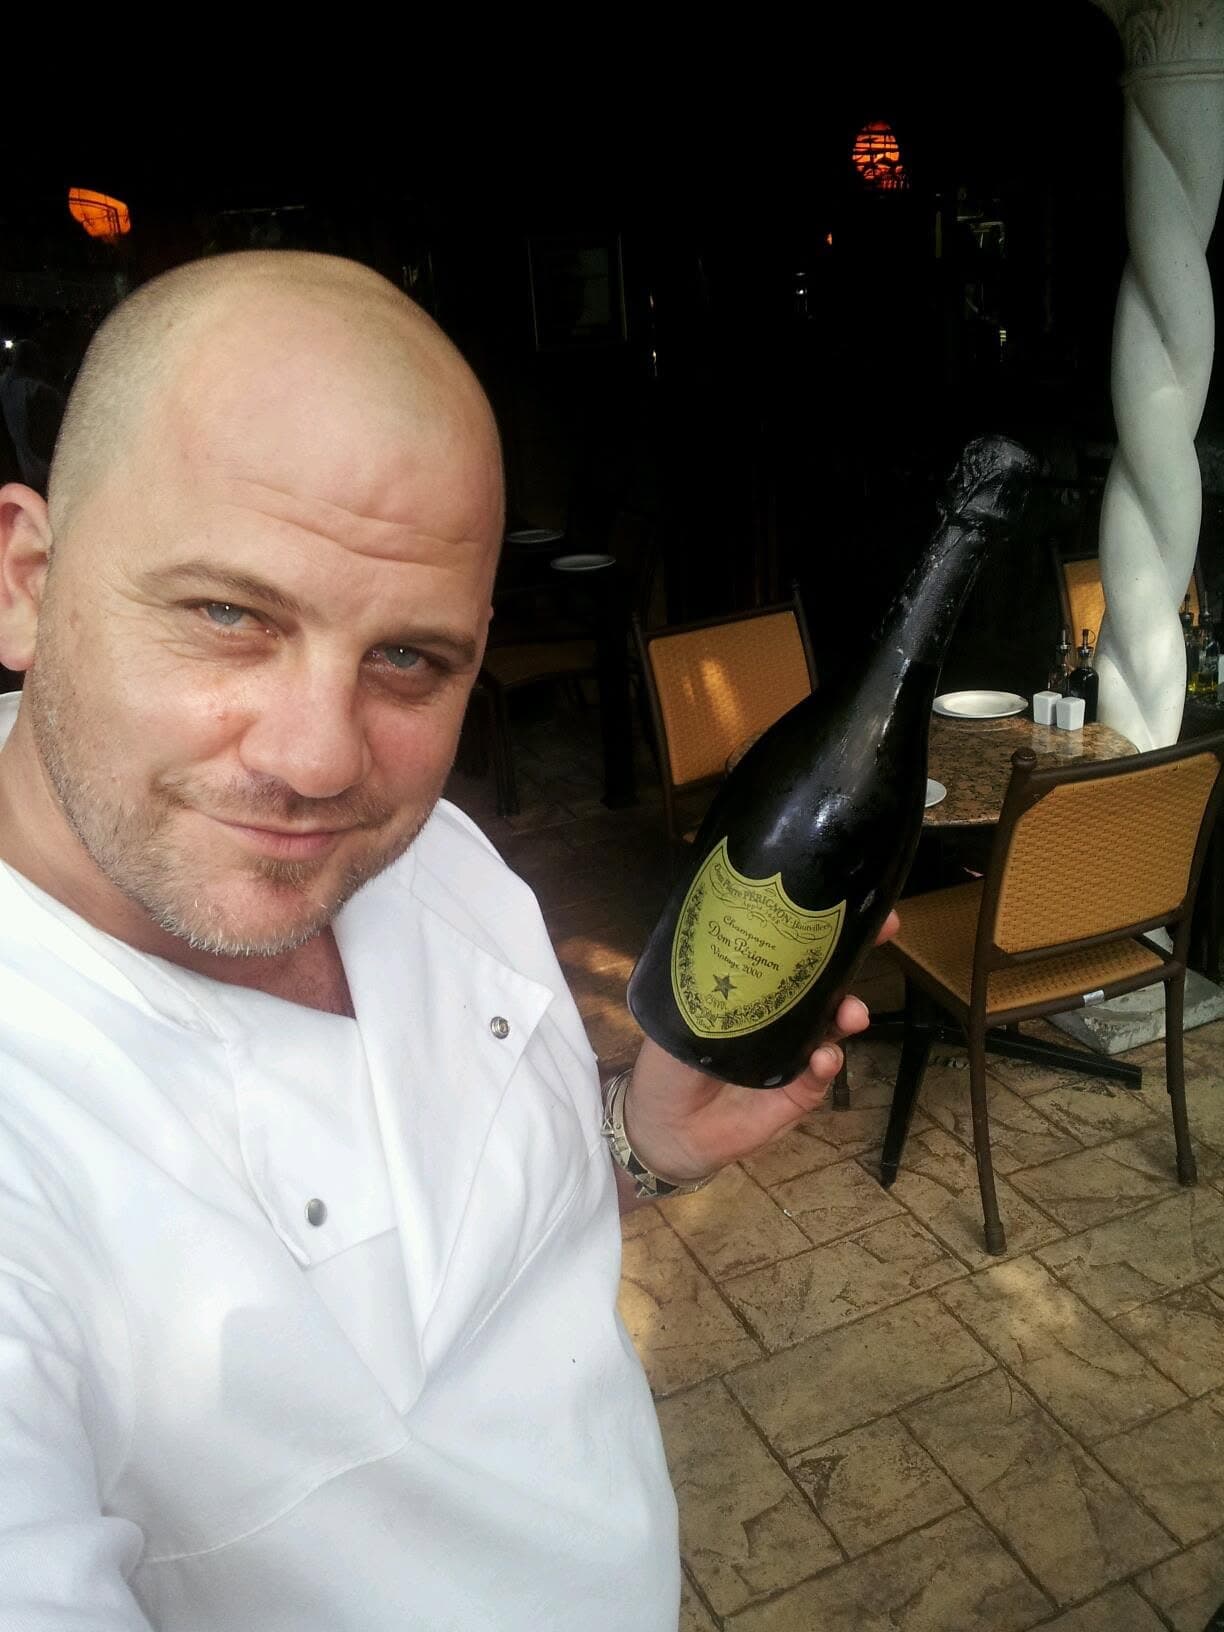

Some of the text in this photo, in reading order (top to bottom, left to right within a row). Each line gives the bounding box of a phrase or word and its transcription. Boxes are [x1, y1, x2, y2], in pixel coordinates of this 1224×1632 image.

[708, 920, 779, 971] Dom Pérignon
[723, 915, 776, 950] Champagne
[710, 944, 763, 979] Vintage 2000
